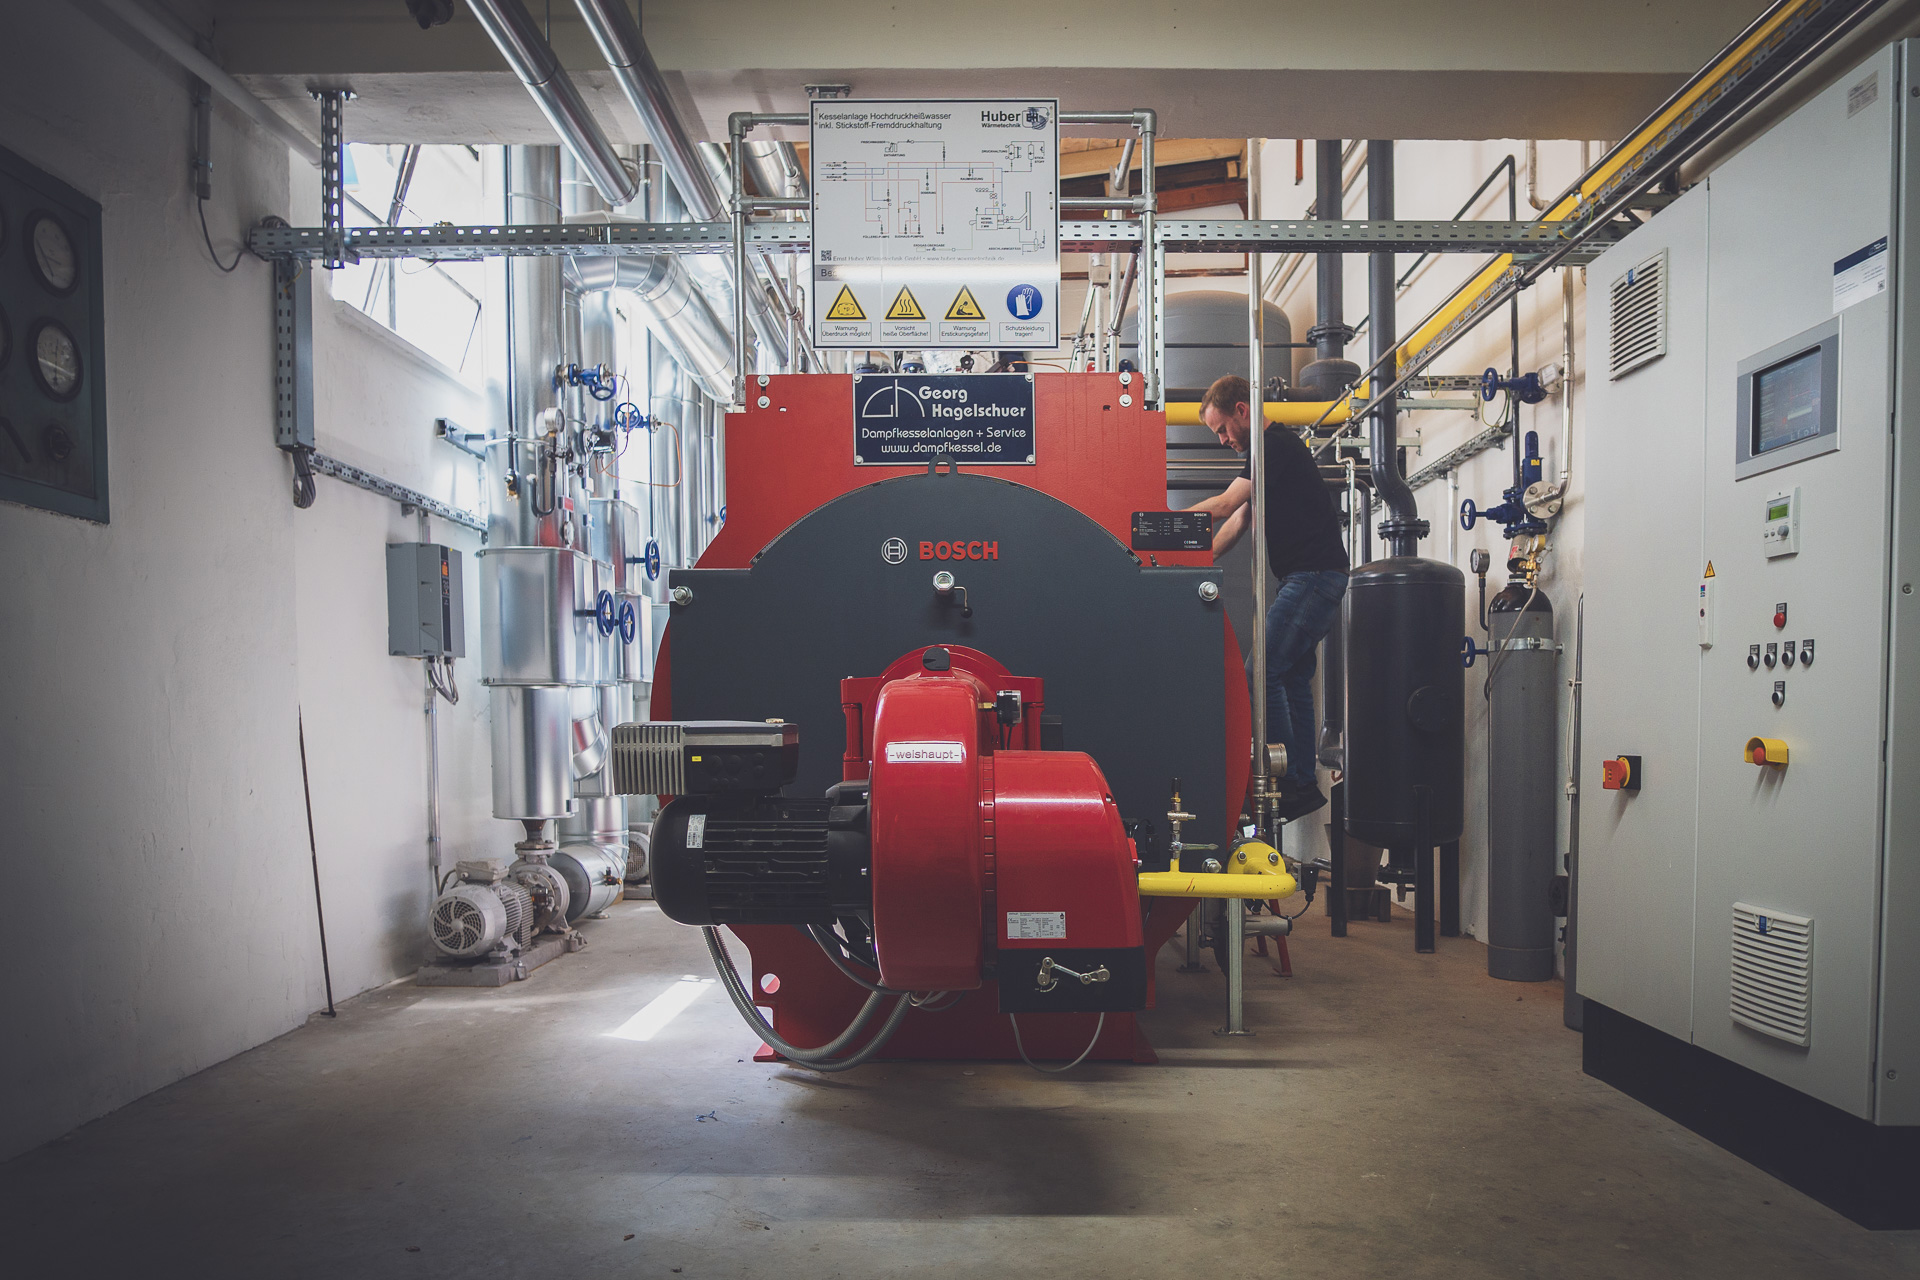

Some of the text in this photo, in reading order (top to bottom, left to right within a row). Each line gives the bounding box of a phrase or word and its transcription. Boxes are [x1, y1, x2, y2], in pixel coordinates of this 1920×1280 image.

[819, 112, 952, 121] Kesselanlage Hochdruckheißwasser
[981, 110, 1021, 122] Huber
[819, 121, 943, 131] inkl. Stickstoff-Fremddruckhaltung
[918, 386, 968, 402] Georg
[932, 403, 1026, 421] Hagelschuer
[861, 427, 1027, 441] Dampfkesselanlagen + Service
[881, 442, 1003, 456] www.dampfkessel.de
[919, 541, 999, 560] BOSCH
